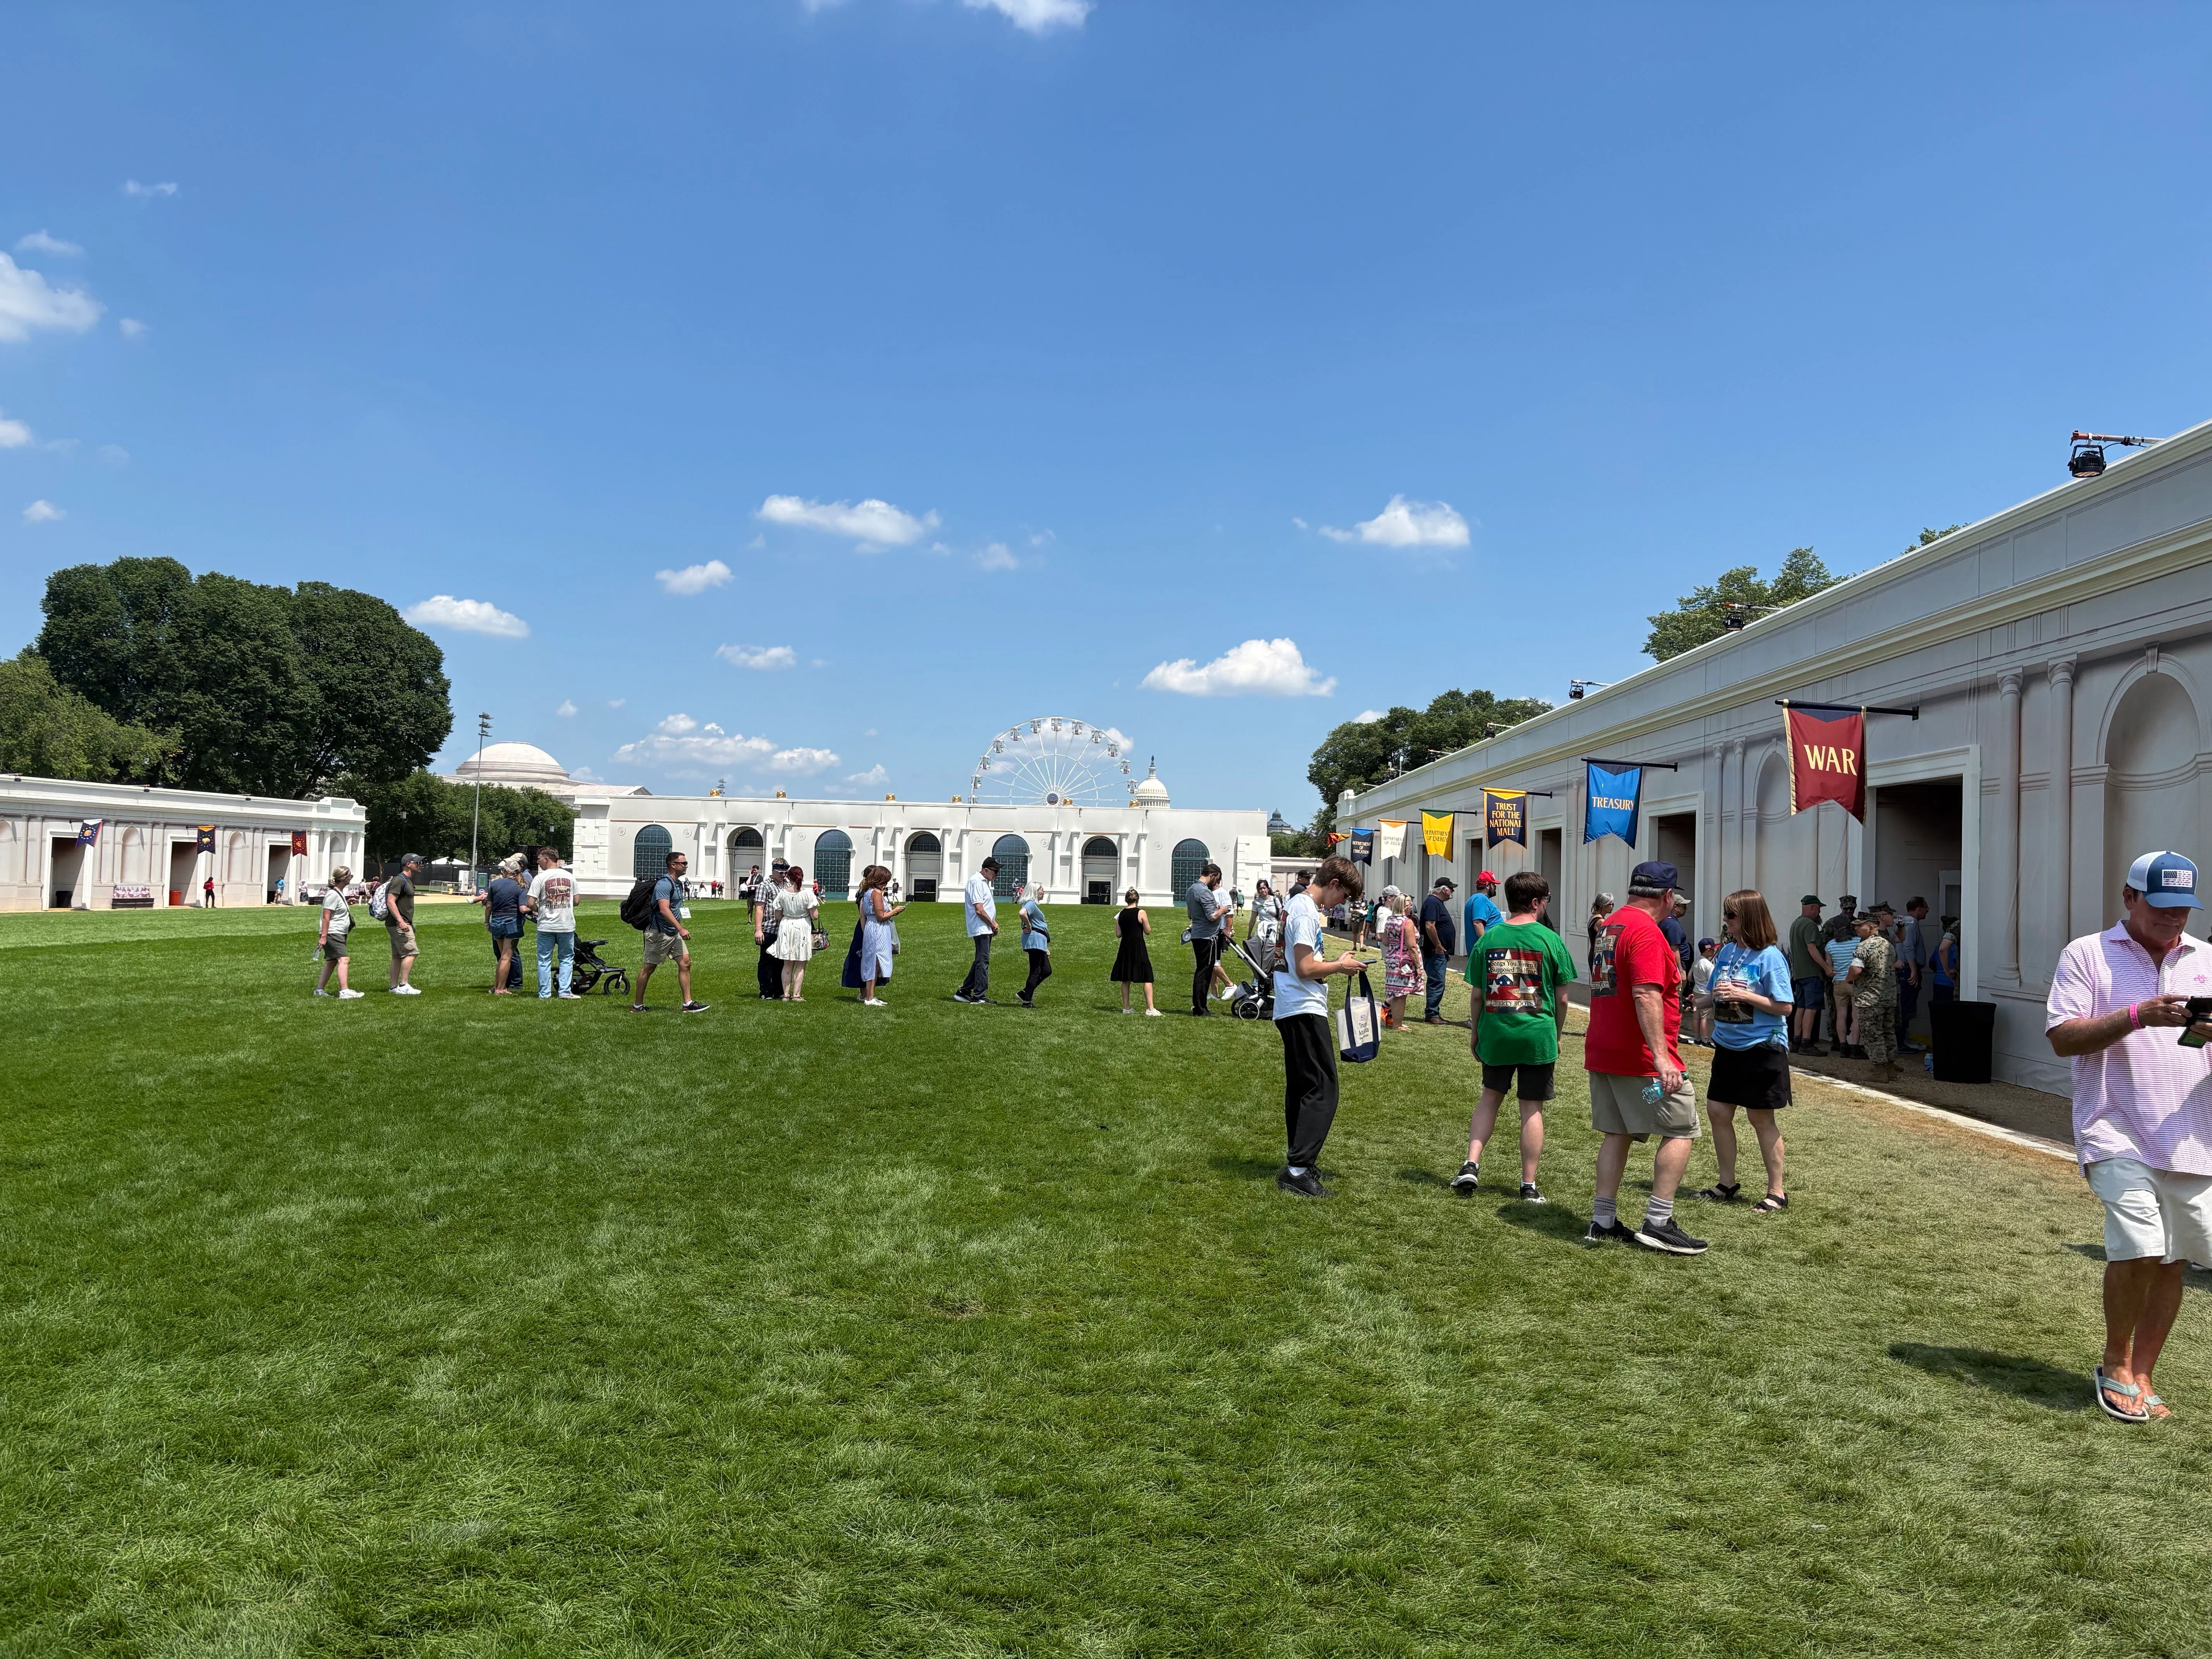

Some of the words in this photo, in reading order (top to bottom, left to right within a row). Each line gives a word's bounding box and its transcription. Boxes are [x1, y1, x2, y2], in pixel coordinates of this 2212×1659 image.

[1803, 744, 1857, 776] WAR
[1495, 802, 1517, 811] TRUST
[1592, 797, 1635, 811] TREASURY
[1492, 811, 1505, 819] FOR
[1507, 811, 1520, 819] THE
[1489, 819, 1523, 828] NATIONAL
[1497, 827, 1516, 836] MALL
